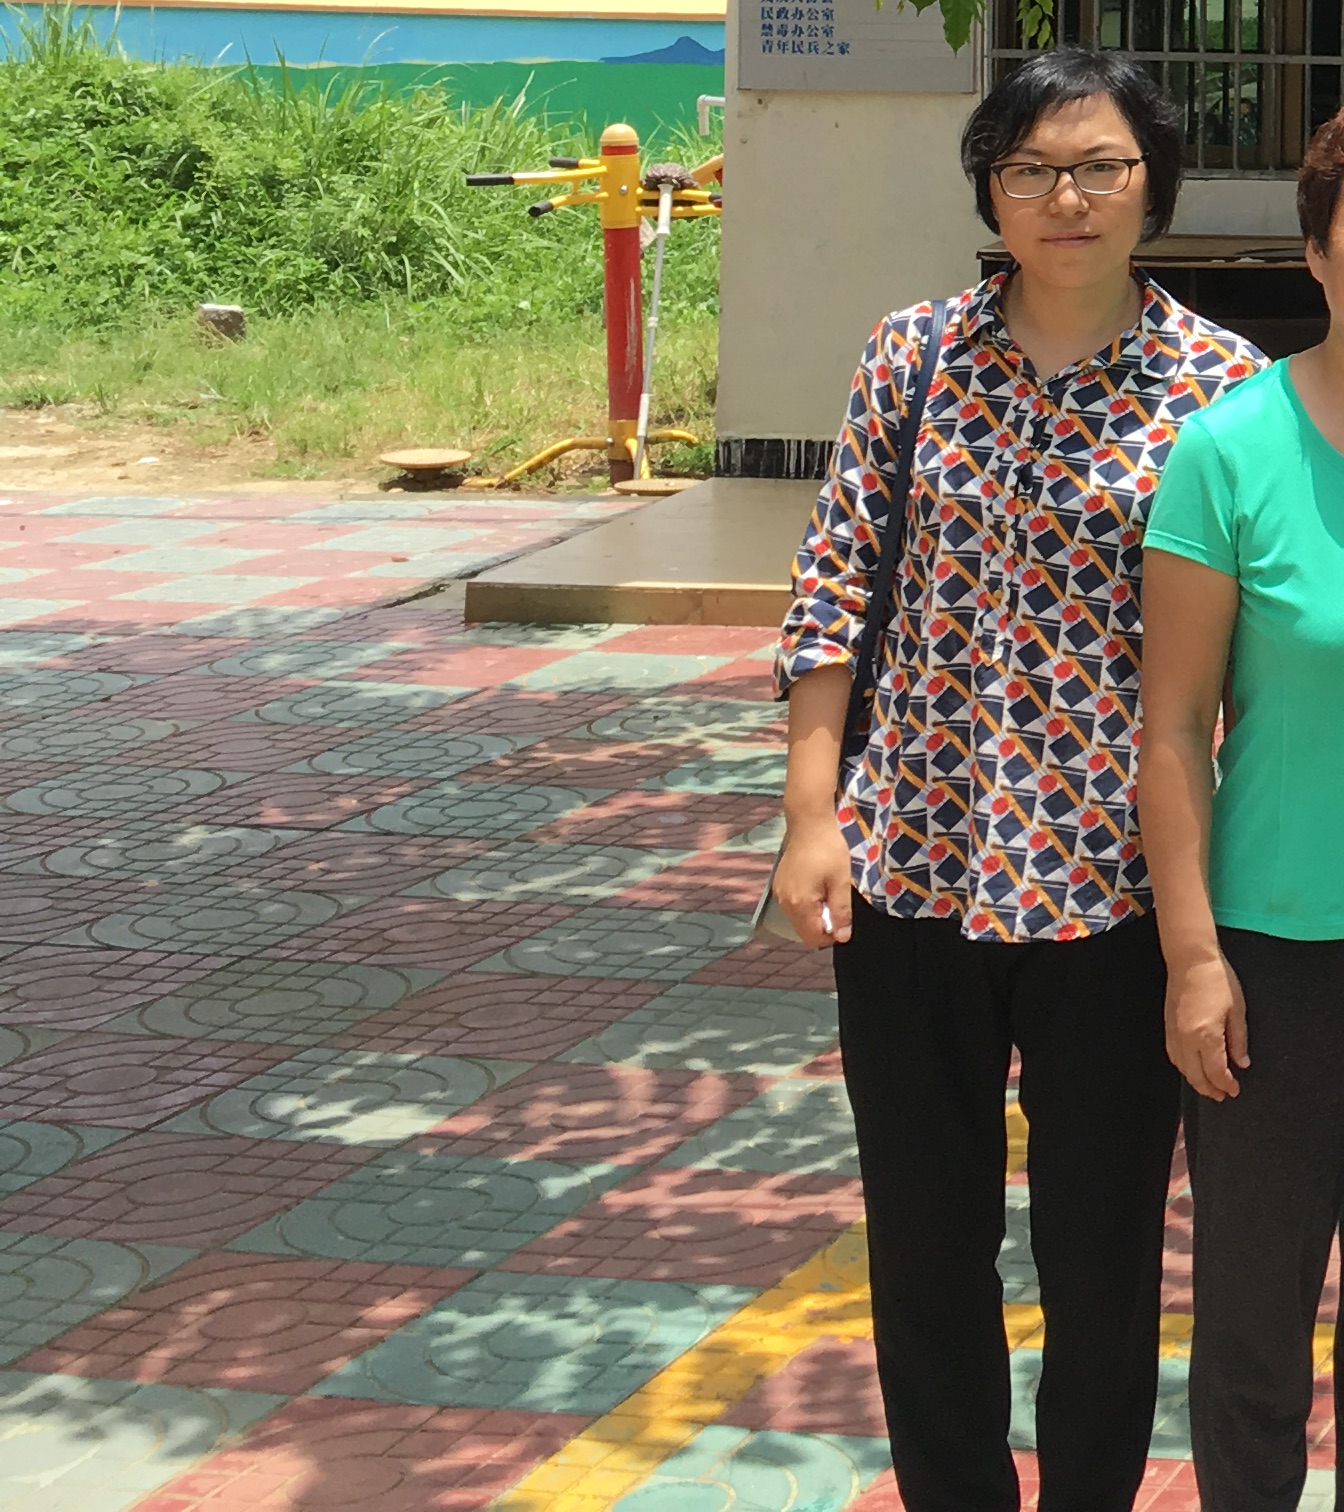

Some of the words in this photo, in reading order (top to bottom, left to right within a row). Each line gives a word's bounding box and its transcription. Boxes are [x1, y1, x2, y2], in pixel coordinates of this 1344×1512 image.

[761, 7, 834, 21] 民政办公室
[761, 24, 834, 37] 禁毒办公室
[761, 40, 850, 55] 青年民兵之家
